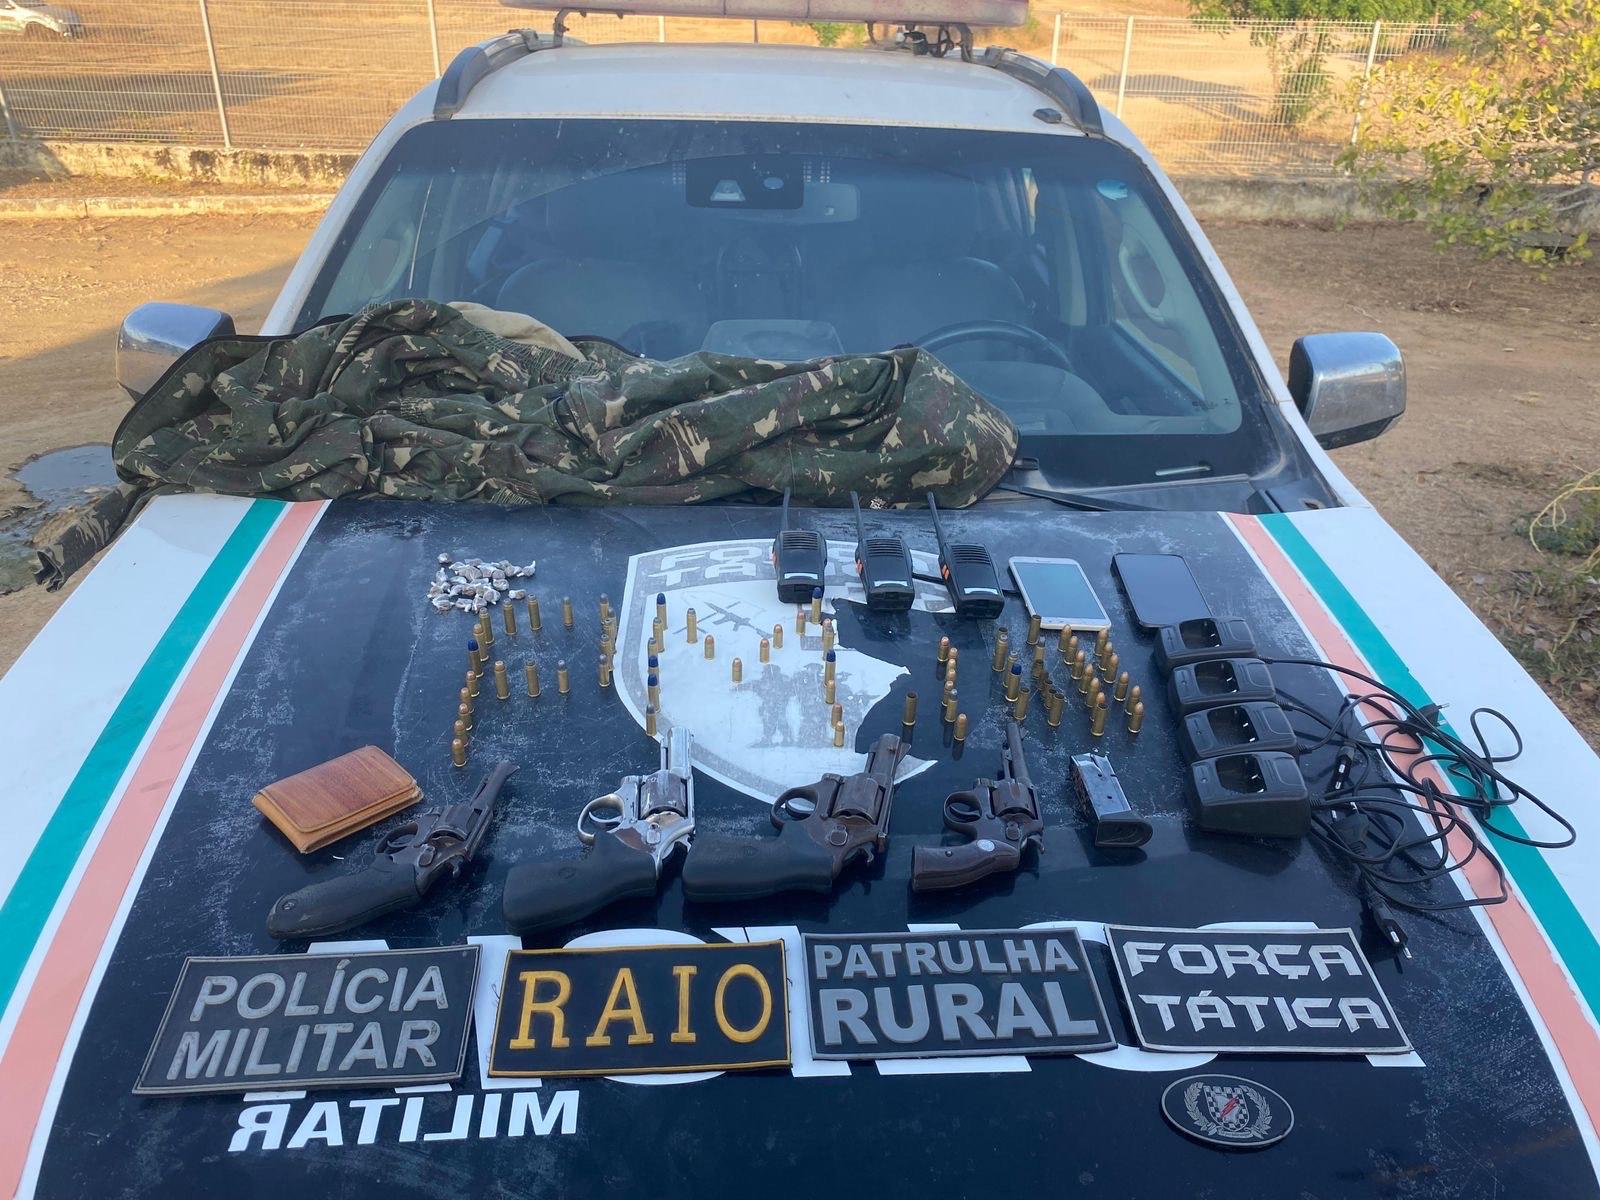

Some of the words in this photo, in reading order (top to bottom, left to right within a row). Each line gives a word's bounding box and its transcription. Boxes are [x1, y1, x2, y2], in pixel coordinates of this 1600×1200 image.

[189, 958, 449, 1022] POLÍCIA
[813, 939, 1080, 980] PATRULHA
[1121, 941, 1363, 981] FORÇA
[508, 963, 772, 1050] RAIO
[819, 981, 1100, 1046] RURAL
[1137, 990, 1391, 1034] TÁTICA
[166, 1019, 441, 1080] MILITAR
